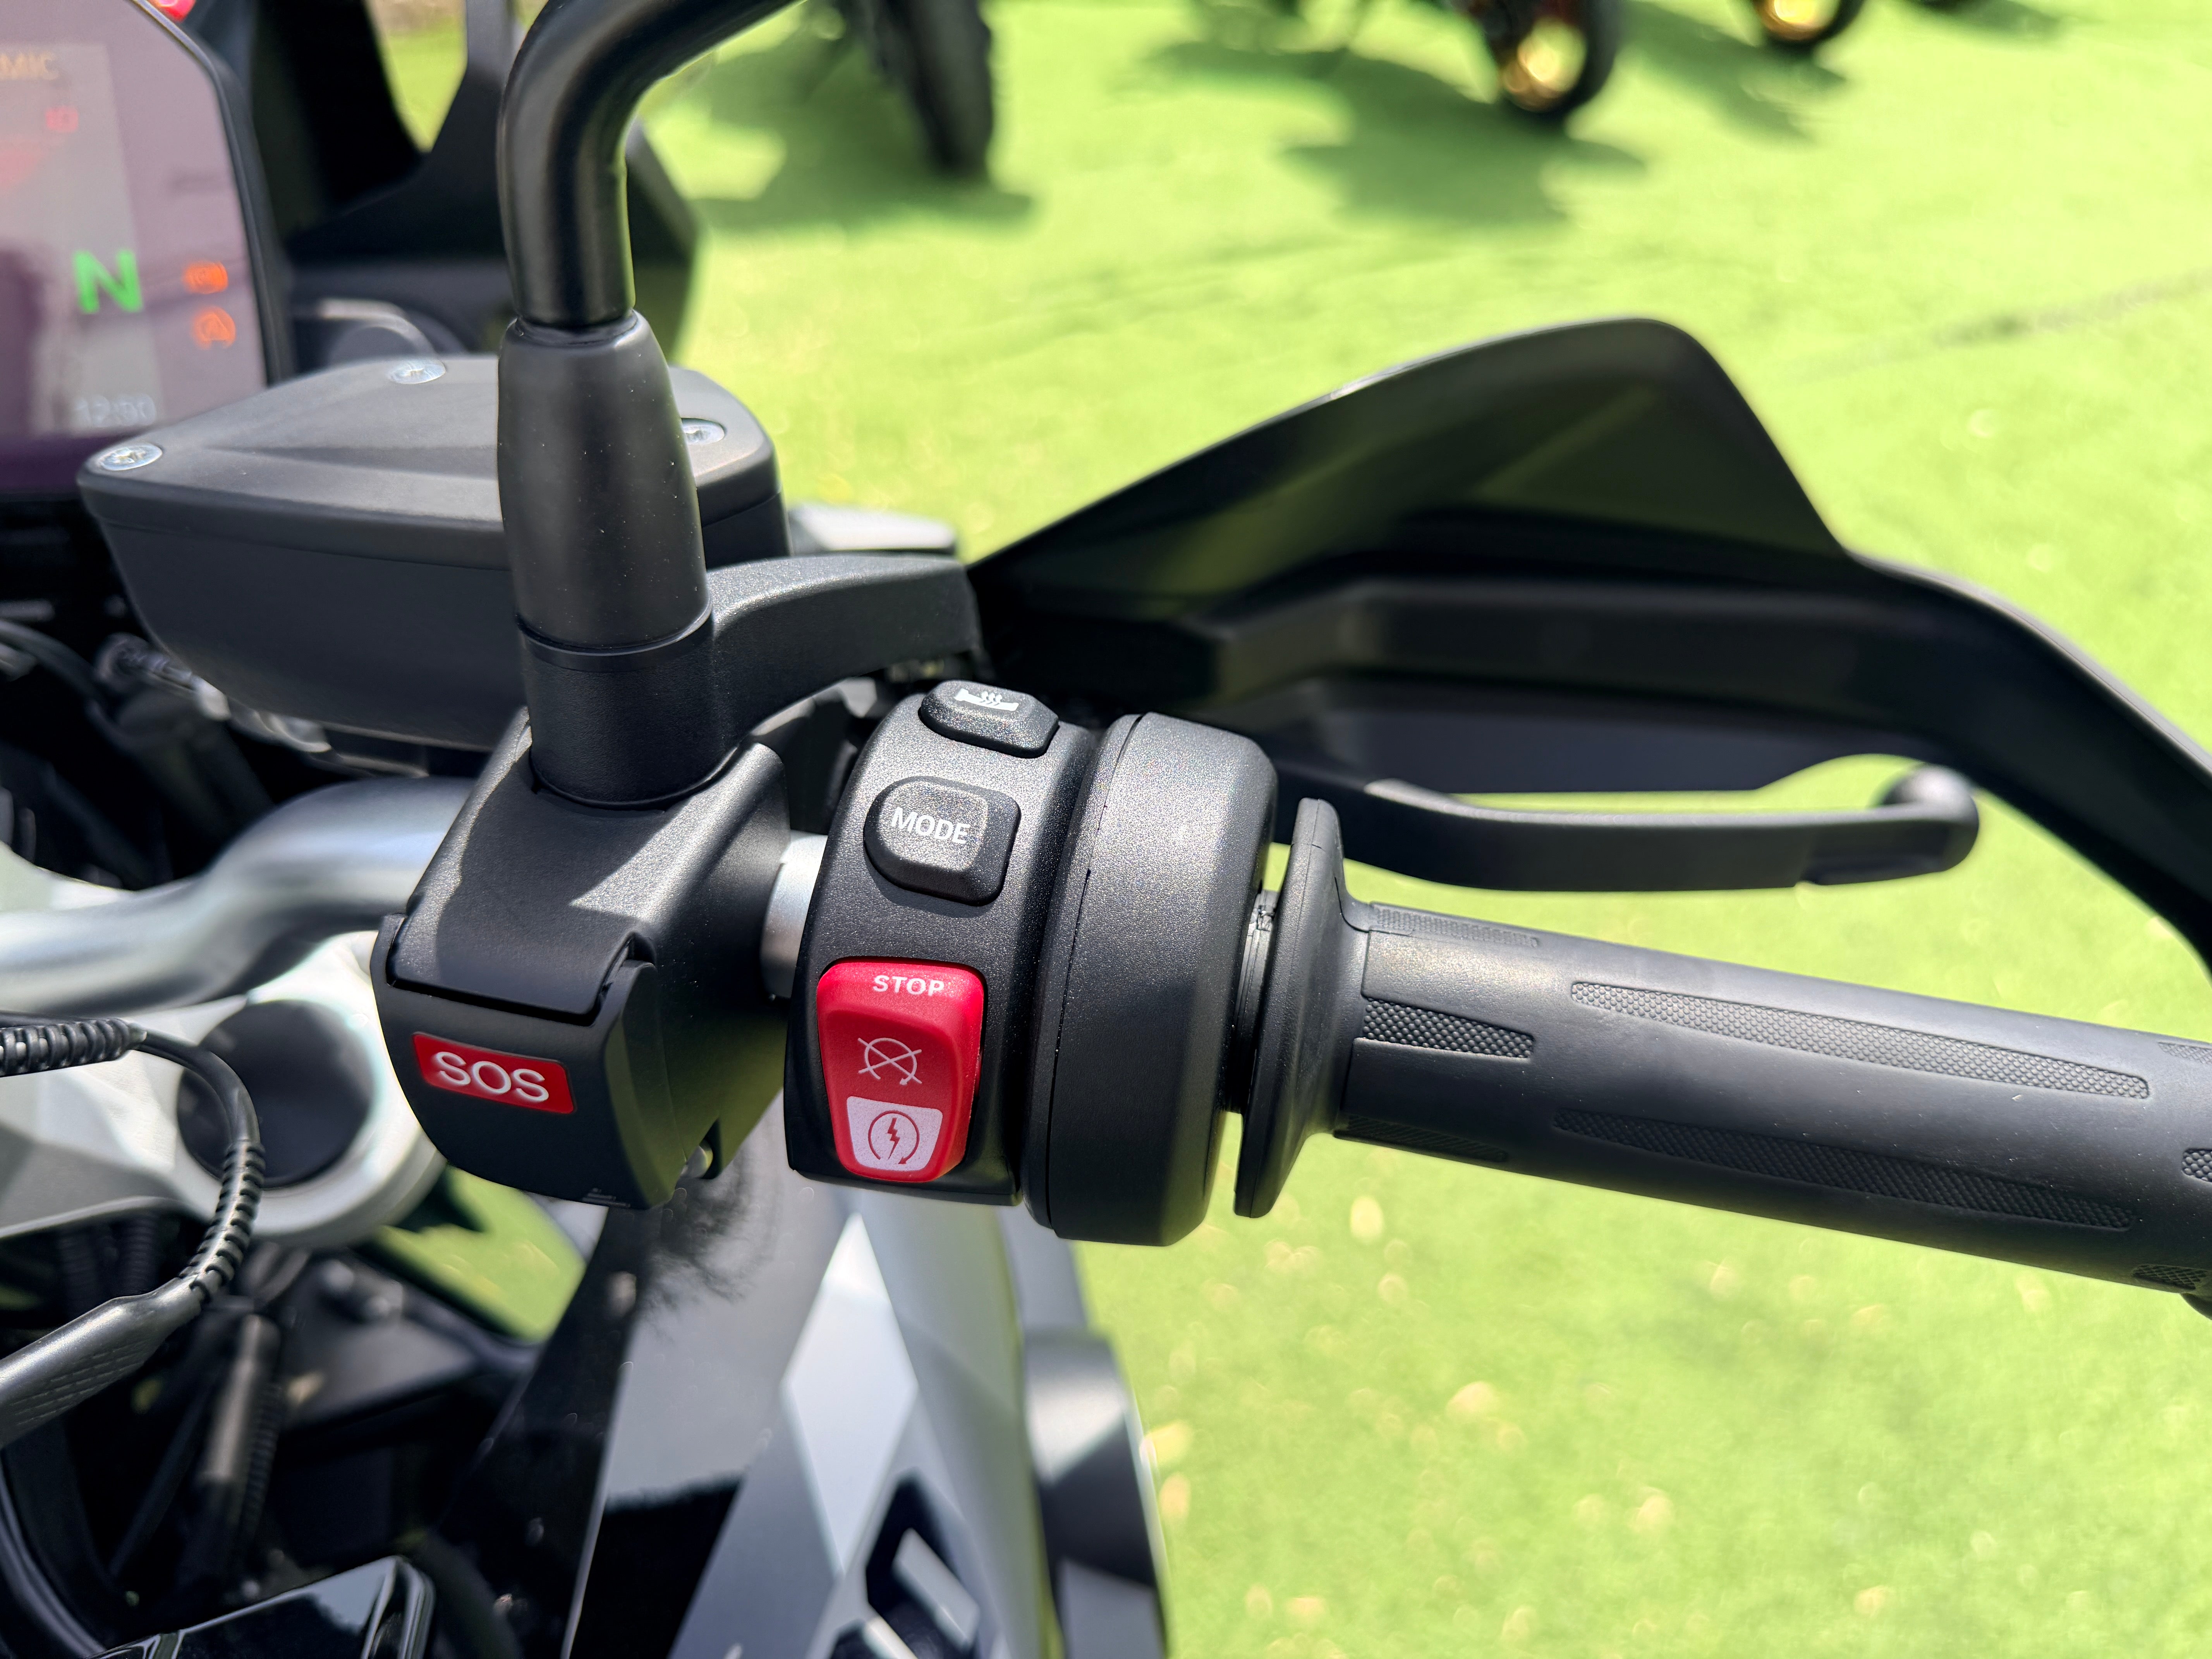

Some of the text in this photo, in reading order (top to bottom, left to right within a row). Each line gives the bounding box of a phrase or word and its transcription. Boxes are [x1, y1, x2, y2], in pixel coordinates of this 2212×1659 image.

[72, 249, 143, 314] N
[891, 807, 971, 845] MODE
[872, 975, 945, 996] STOP
[436, 1051, 549, 1102] SOS
